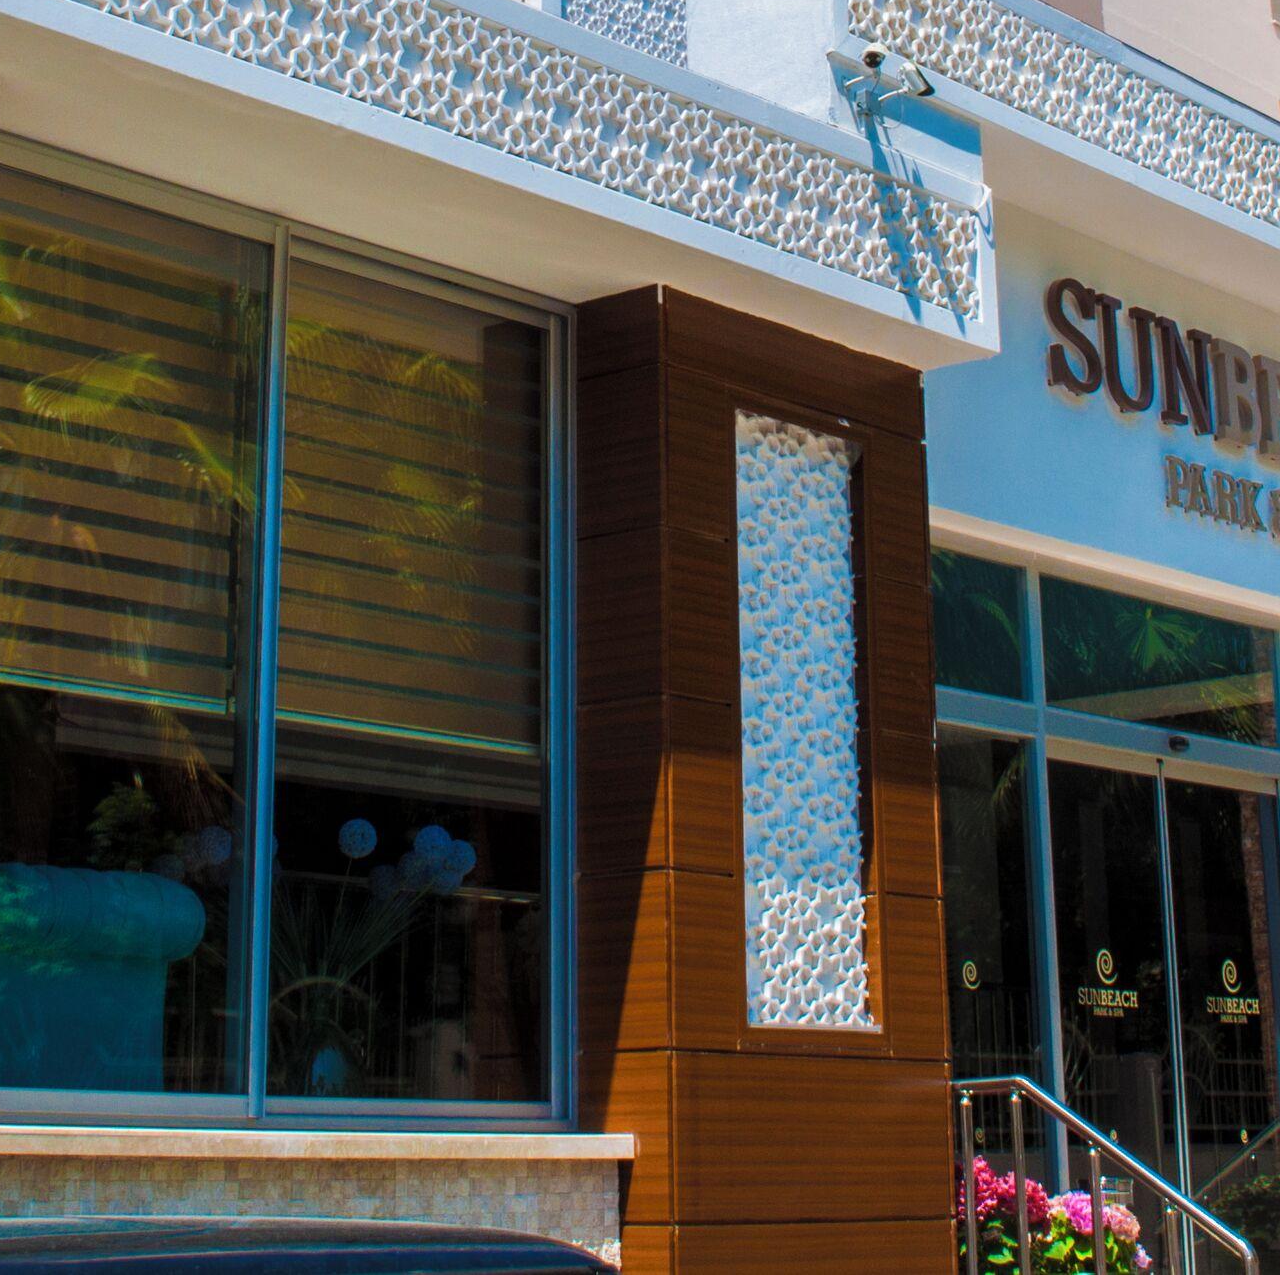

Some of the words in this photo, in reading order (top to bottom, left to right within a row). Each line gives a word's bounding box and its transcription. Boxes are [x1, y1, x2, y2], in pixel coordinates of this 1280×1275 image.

[1165, 454, 1267, 532] PARK
[1078, 986, 1138, 1008] SUNBEACH
[1207, 996, 1260, 1015] SUNBEACH
